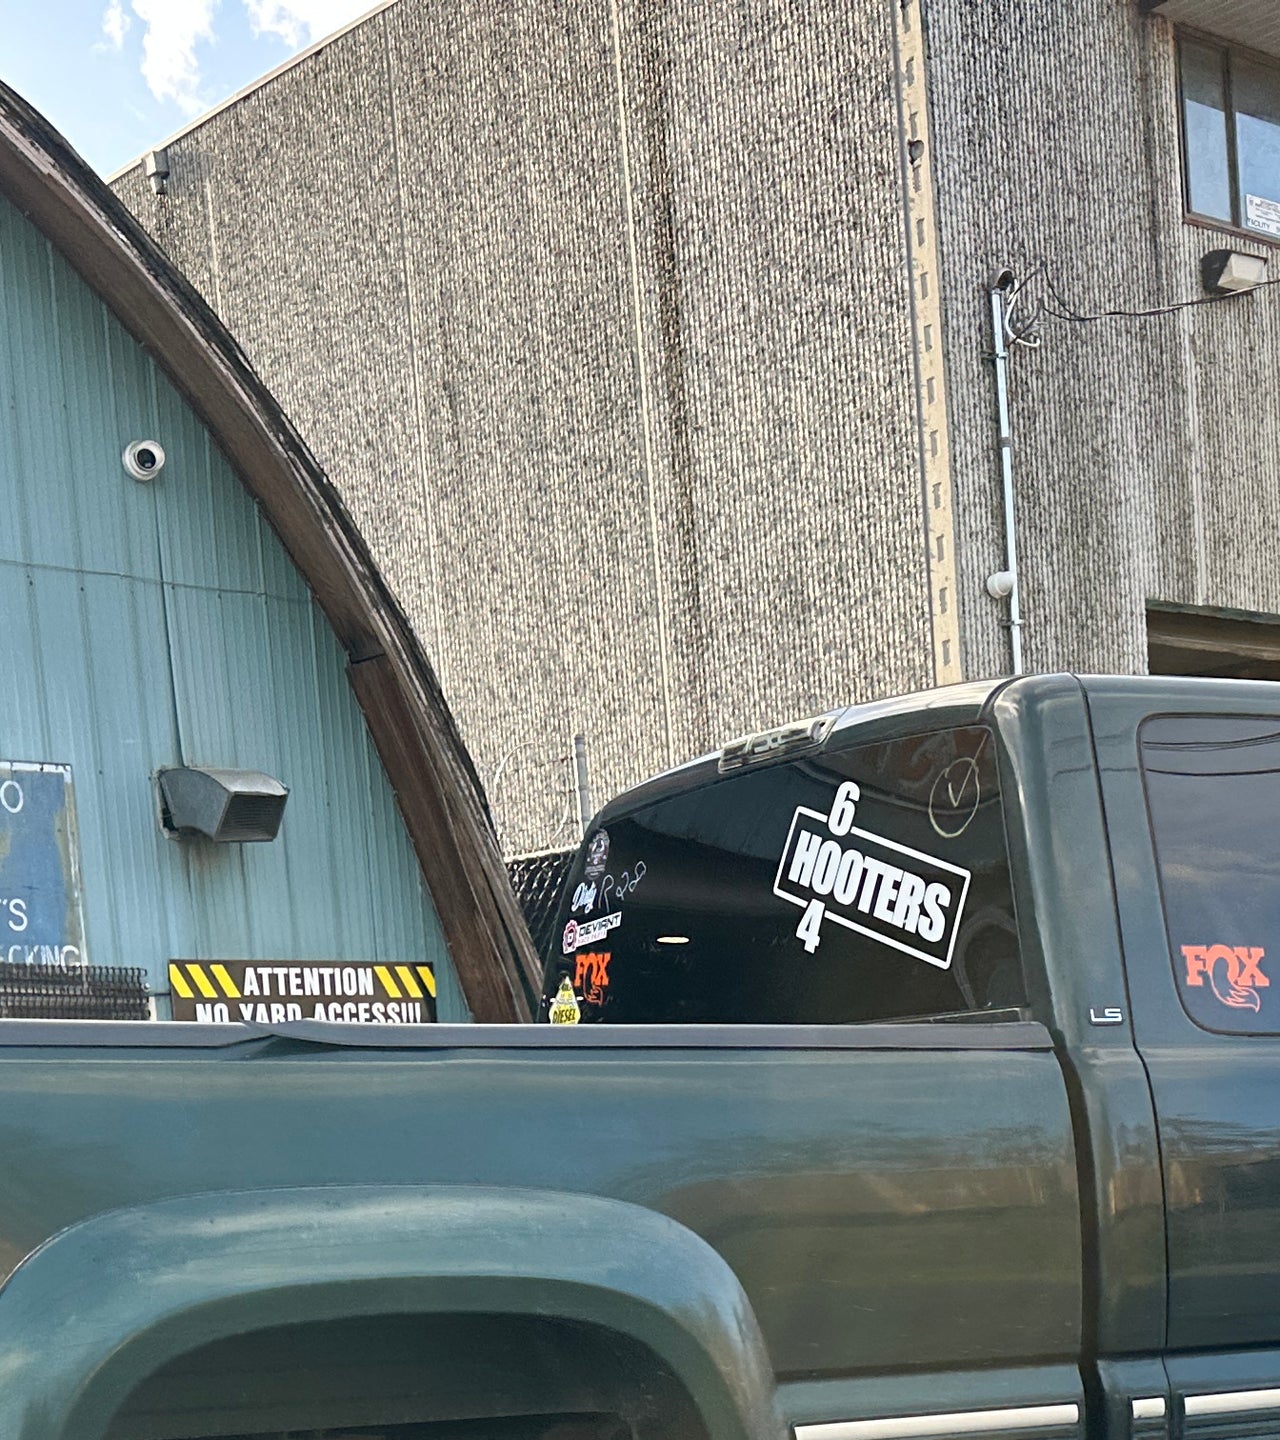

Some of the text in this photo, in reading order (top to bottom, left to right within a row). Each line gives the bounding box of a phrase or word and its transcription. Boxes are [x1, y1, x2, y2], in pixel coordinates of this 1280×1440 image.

[827, 780, 861, 837] 6
[787, 829, 952, 943] HOOTERS
[795, 898, 826, 954] 4
[243, 966, 375, 997] ATTENTION
[574, 952, 611, 1005] FOX
[1180, 944, 1270, 1013] FOX
[195, 1003, 230, 1023] NO
[239, 1003, 303, 1023] YARD
[1089, 1008, 1123, 1023] LS
